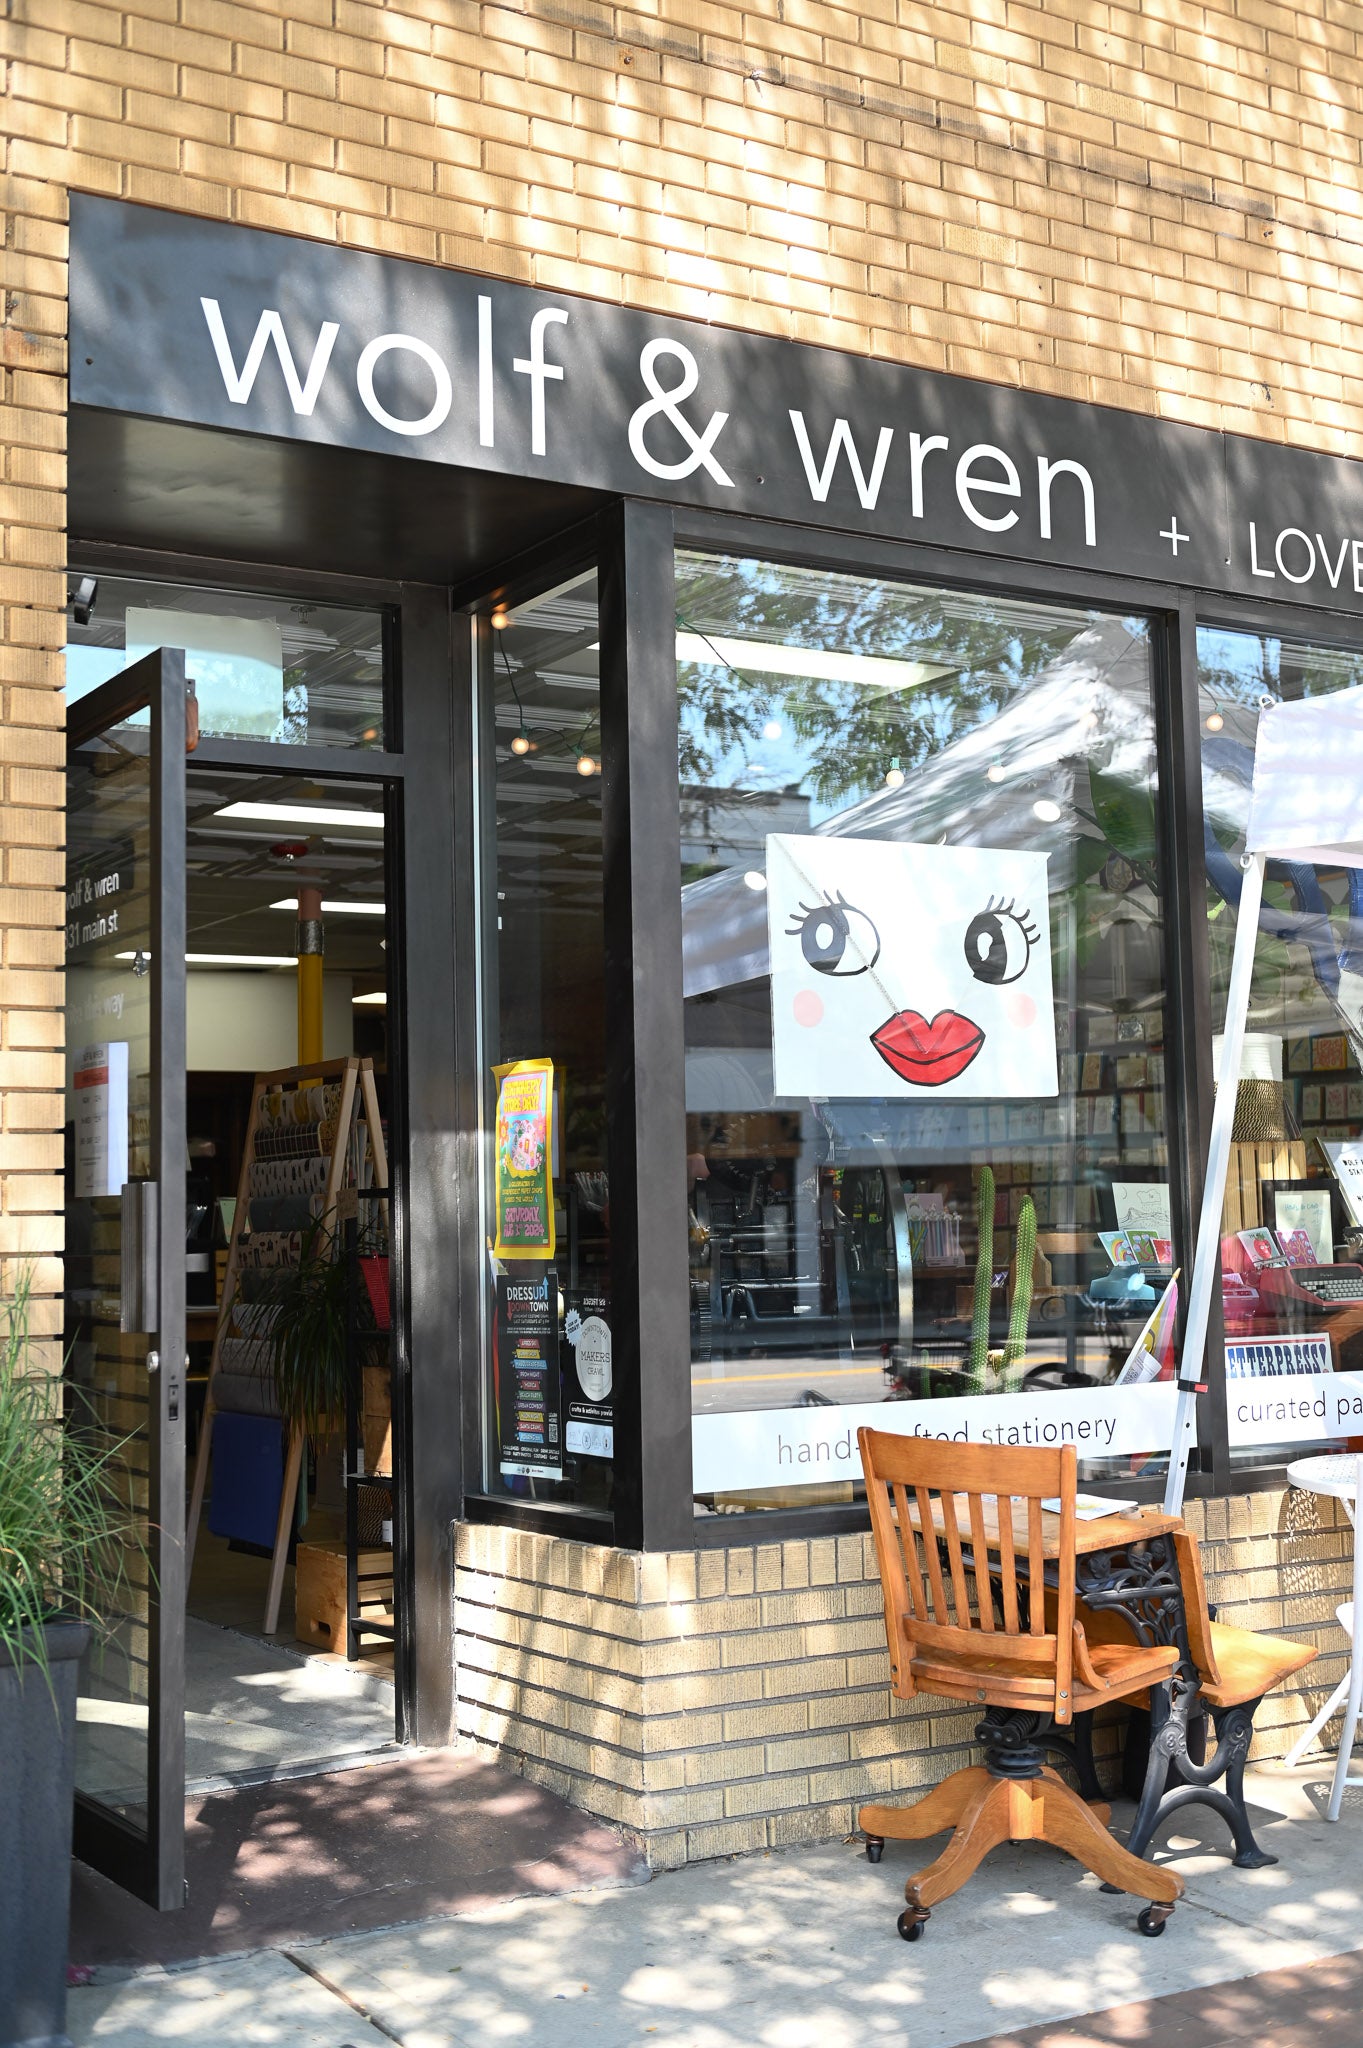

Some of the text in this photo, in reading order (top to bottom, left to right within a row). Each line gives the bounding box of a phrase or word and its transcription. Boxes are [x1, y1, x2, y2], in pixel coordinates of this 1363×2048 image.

[200, 294, 569, 456] wolf
[628, 337, 737, 487] &
[789, 409, 1098, 547] wren
[84, 878, 93, 904] &
[94, 872, 120, 899] wren
[82, 913, 106, 943] main
[108, 909, 119, 933] st
[103, 991, 125, 1020] way
[505, 1206, 540, 1223] SATURDAY
[525, 1223, 545, 1237] 2024
[511, 1301, 549, 1312] DOWNTOWN
[581, 1350, 611, 1363] MAKERS
[1226, 1343, 1327, 1379] ETTERPRESS!
[1237, 1390, 1327, 1423] curated
[779, 1416, 1118, 1465] hand-fted stationery
